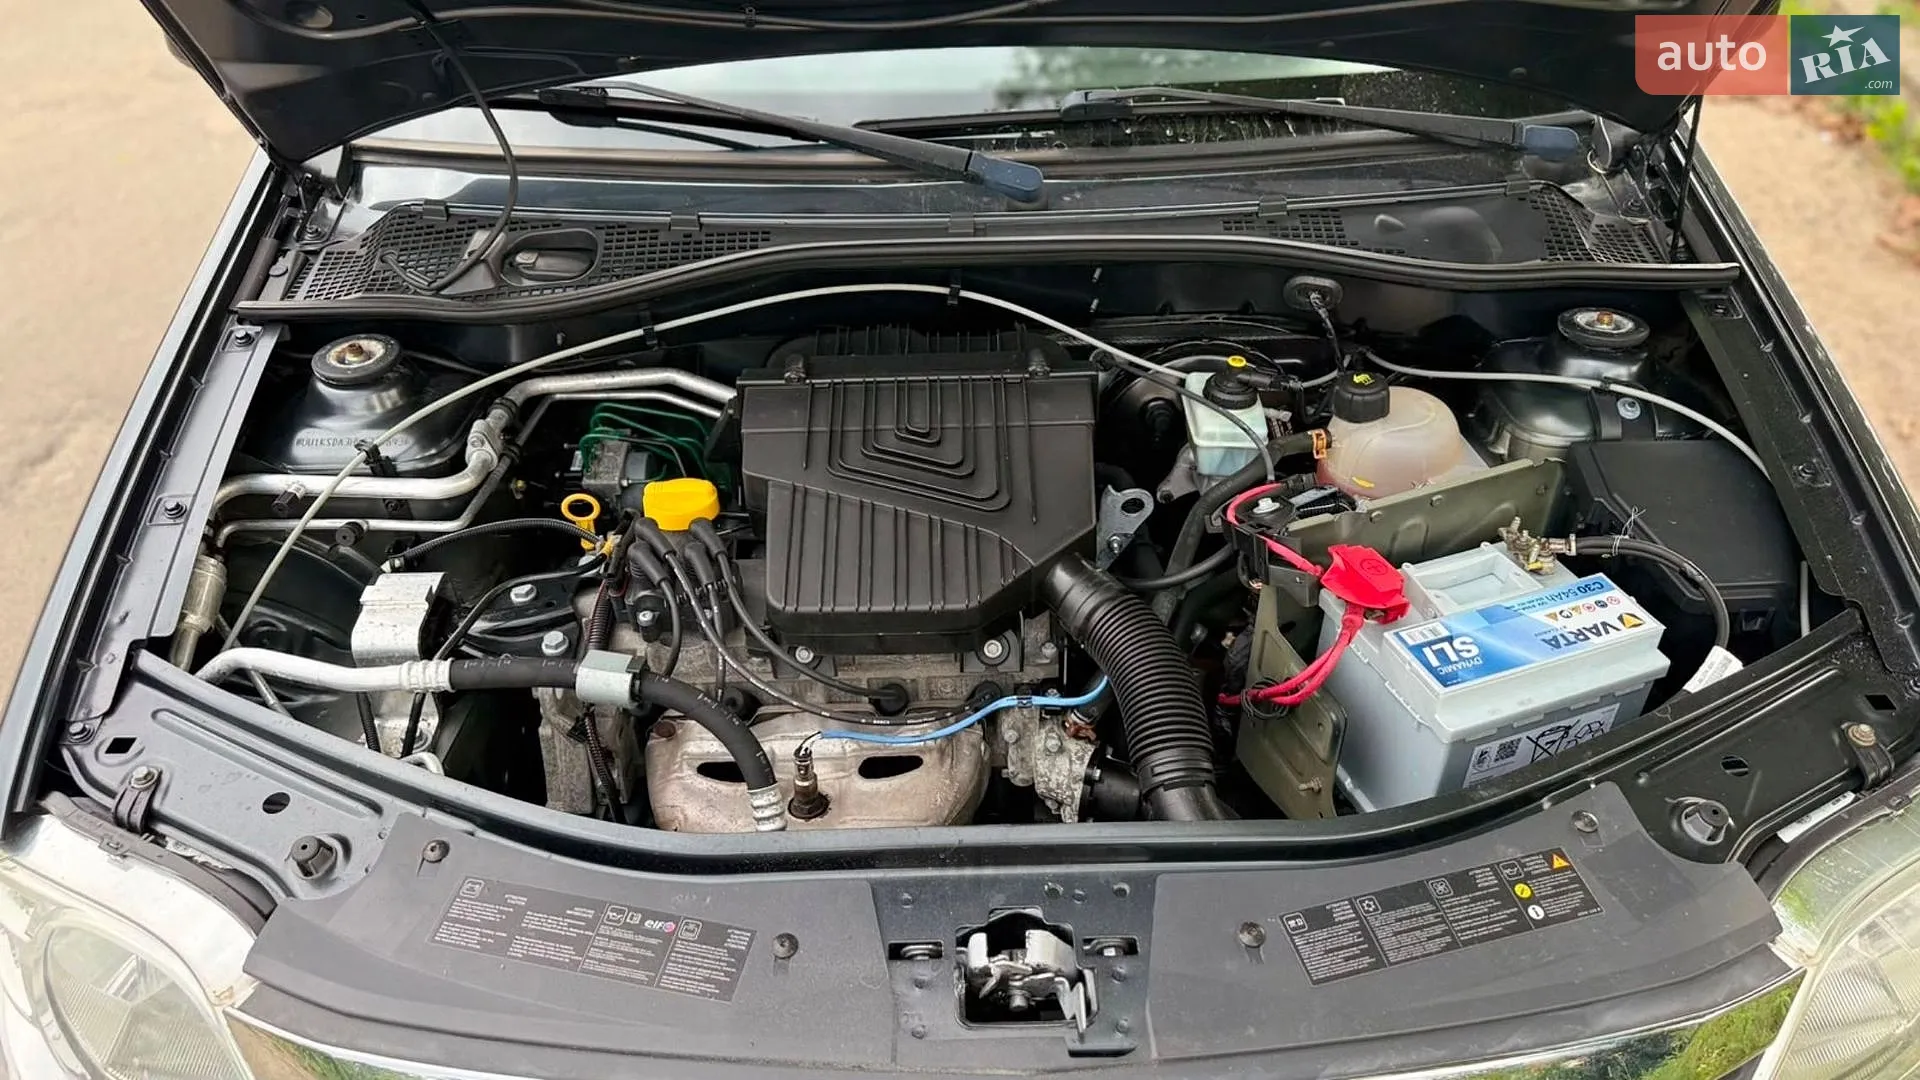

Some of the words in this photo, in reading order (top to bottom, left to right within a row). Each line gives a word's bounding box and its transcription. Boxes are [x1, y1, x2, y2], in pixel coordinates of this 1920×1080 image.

[1546, 588, 1578, 602] 54Ah
[1577, 581, 1604, 594] C30
[1541, 621, 1621, 650] VARTA
[1422, 636, 1480, 668] SLI
[1437, 656, 1483, 675] DYNAMIC
[644, 919, 665, 930] elf
